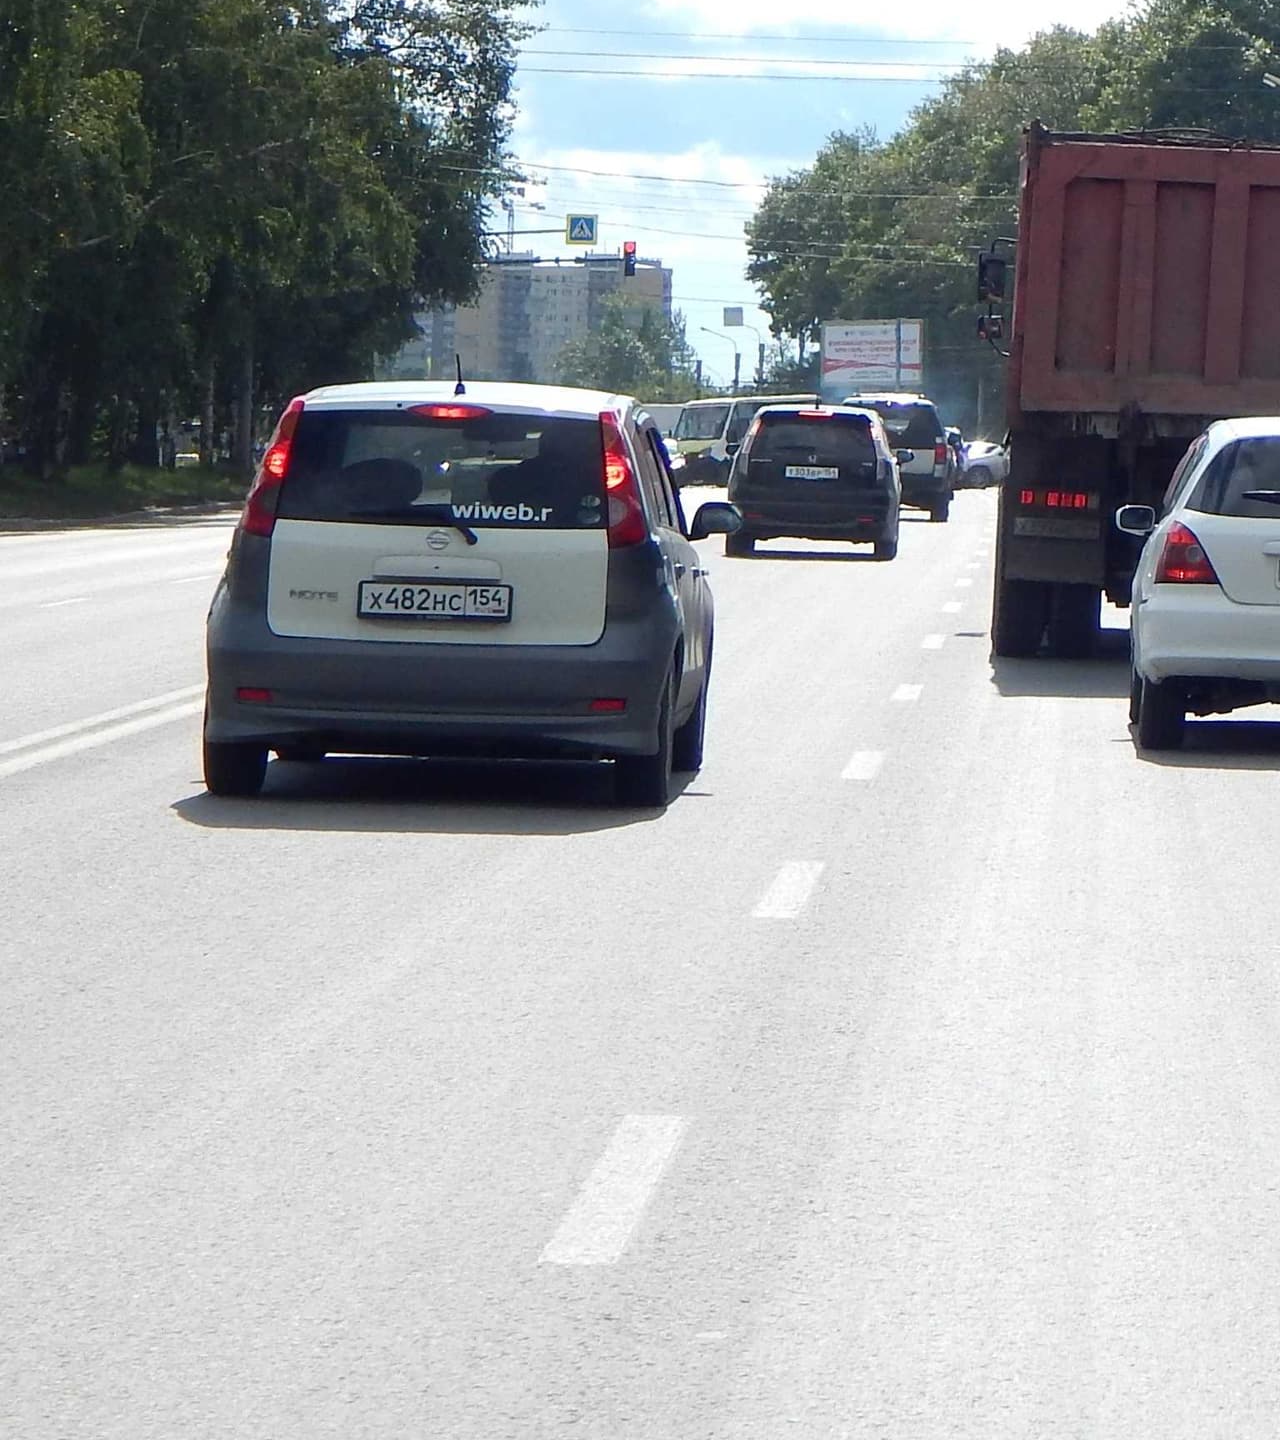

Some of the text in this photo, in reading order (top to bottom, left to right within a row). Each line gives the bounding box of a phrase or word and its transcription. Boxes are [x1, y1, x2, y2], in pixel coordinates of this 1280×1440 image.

[452, 501, 552, 522] wiweb.r
[369, 587, 502, 611] Х482НС 154
